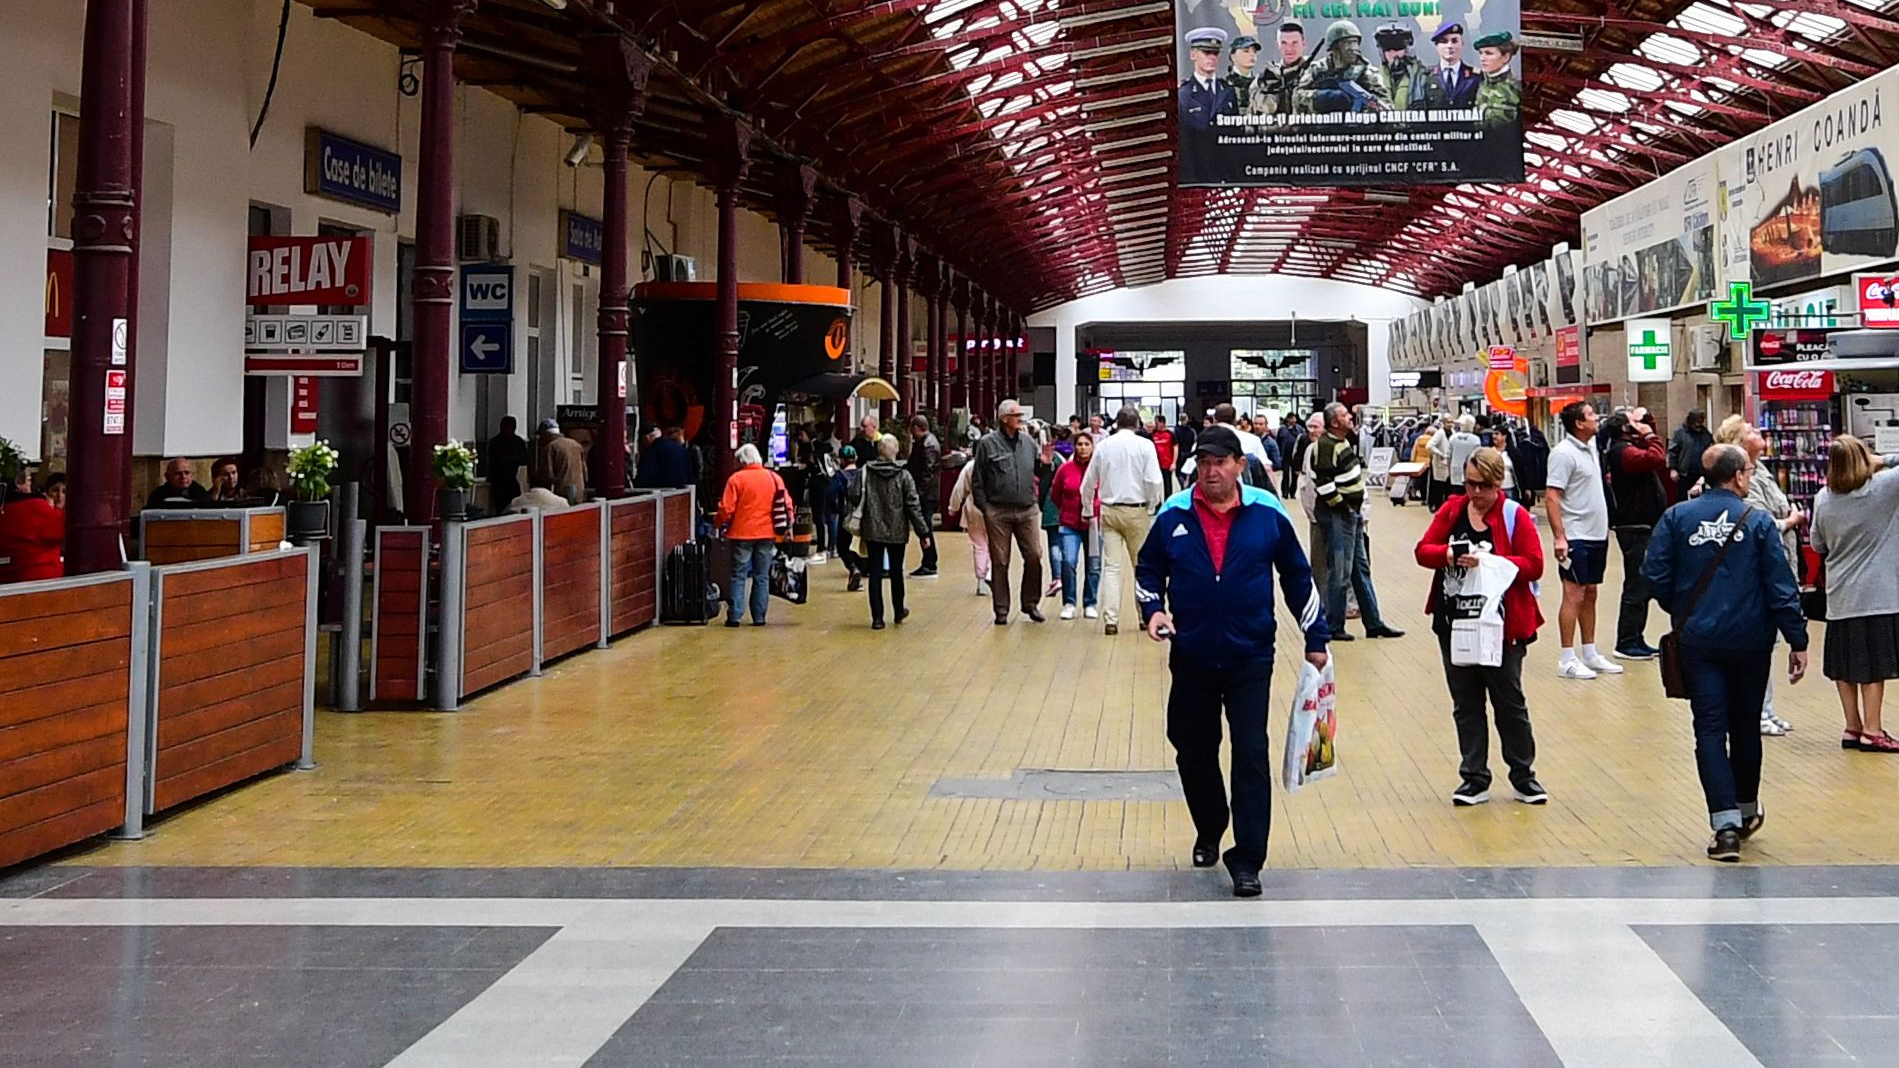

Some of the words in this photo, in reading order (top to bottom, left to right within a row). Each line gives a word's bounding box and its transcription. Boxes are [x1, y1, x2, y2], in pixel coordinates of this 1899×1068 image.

[1357, 2, 1393, 18] MAI
[1758, 130, 1799, 176] HENRI
[1813, 88, 1882, 152] COANDĂ
[324, 146, 350, 185] Case
[353, 154, 366, 190] de
[369, 158, 397, 199] bilete
[251, 240, 352, 297] RELAY
[469, 283, 506, 300] WC
